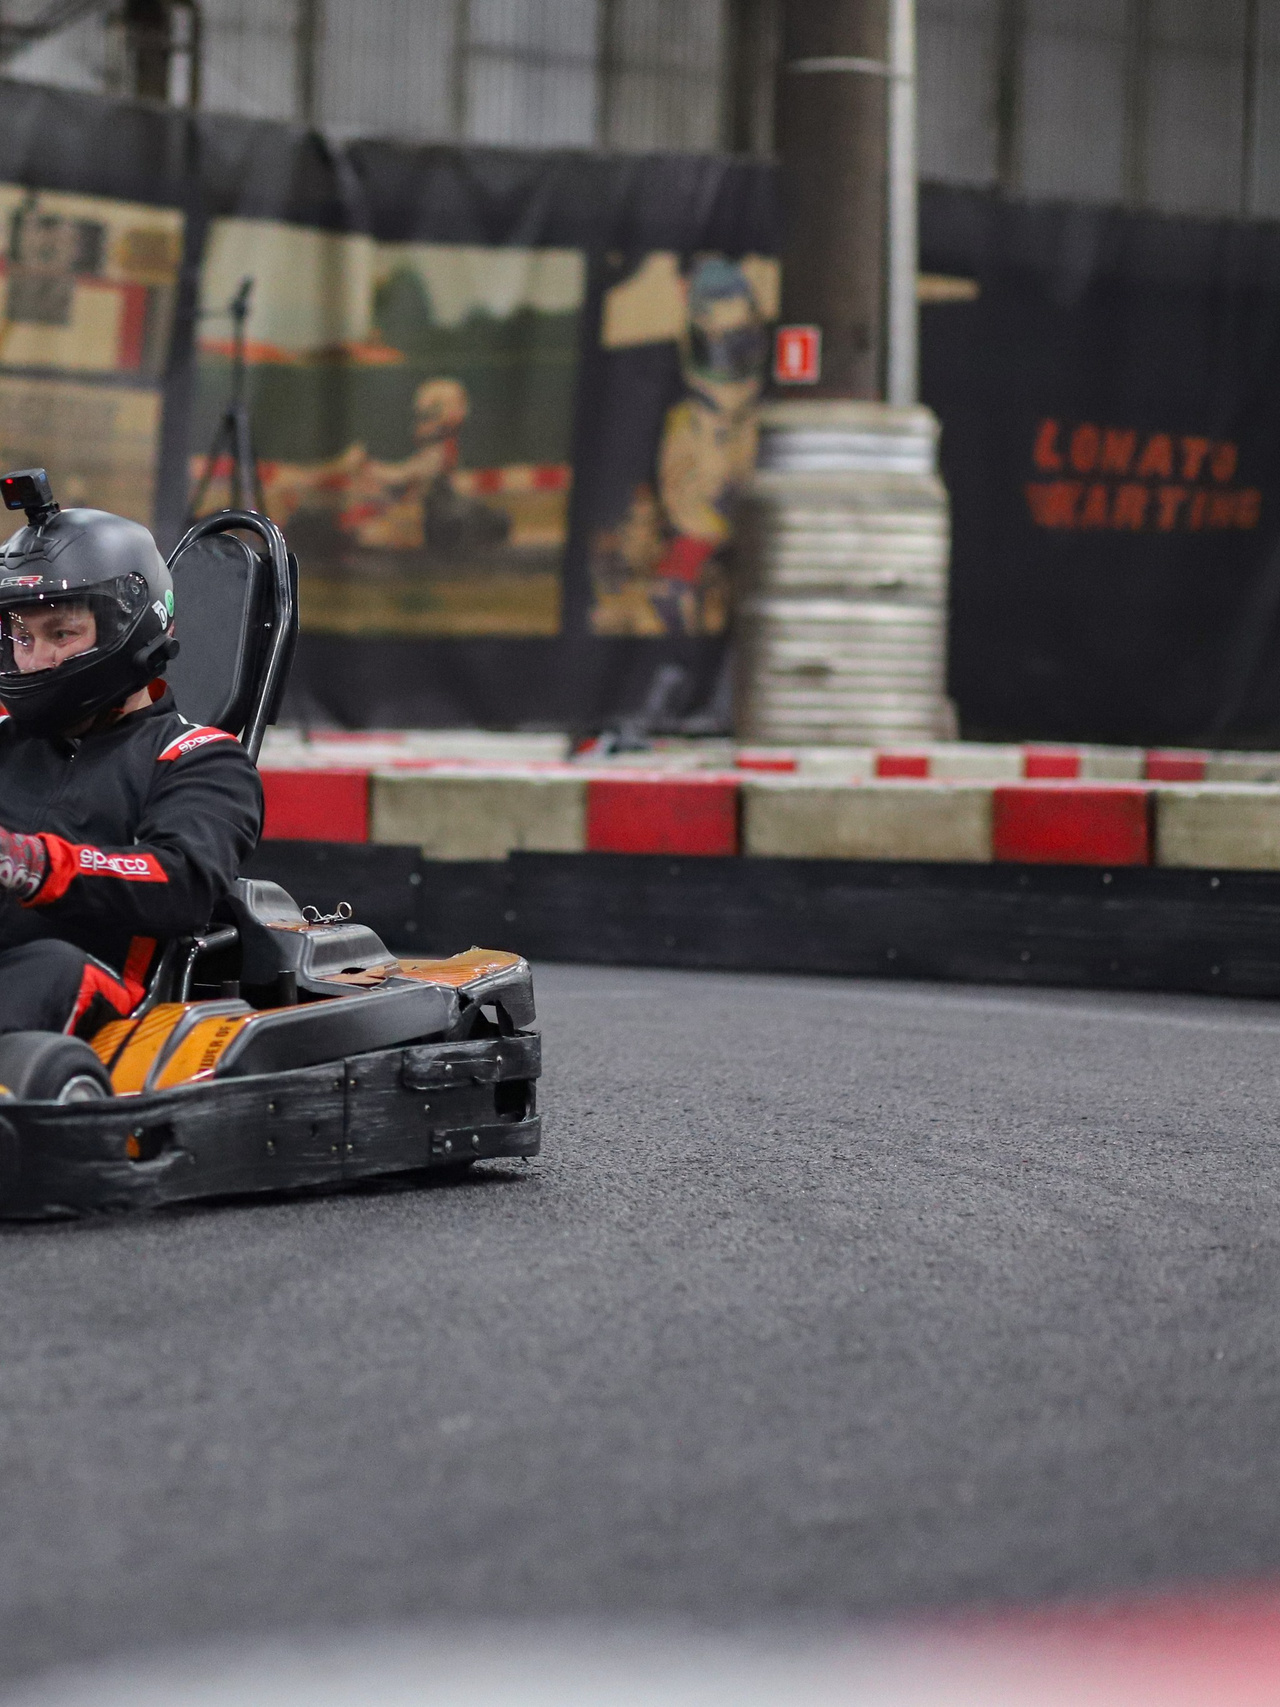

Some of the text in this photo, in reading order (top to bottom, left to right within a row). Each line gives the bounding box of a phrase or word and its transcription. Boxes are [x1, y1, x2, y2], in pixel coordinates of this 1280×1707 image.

[1032, 418, 1238, 482] LONATO
[1032, 480, 1262, 531] KARTING
[80, 849, 150, 873] sparco
